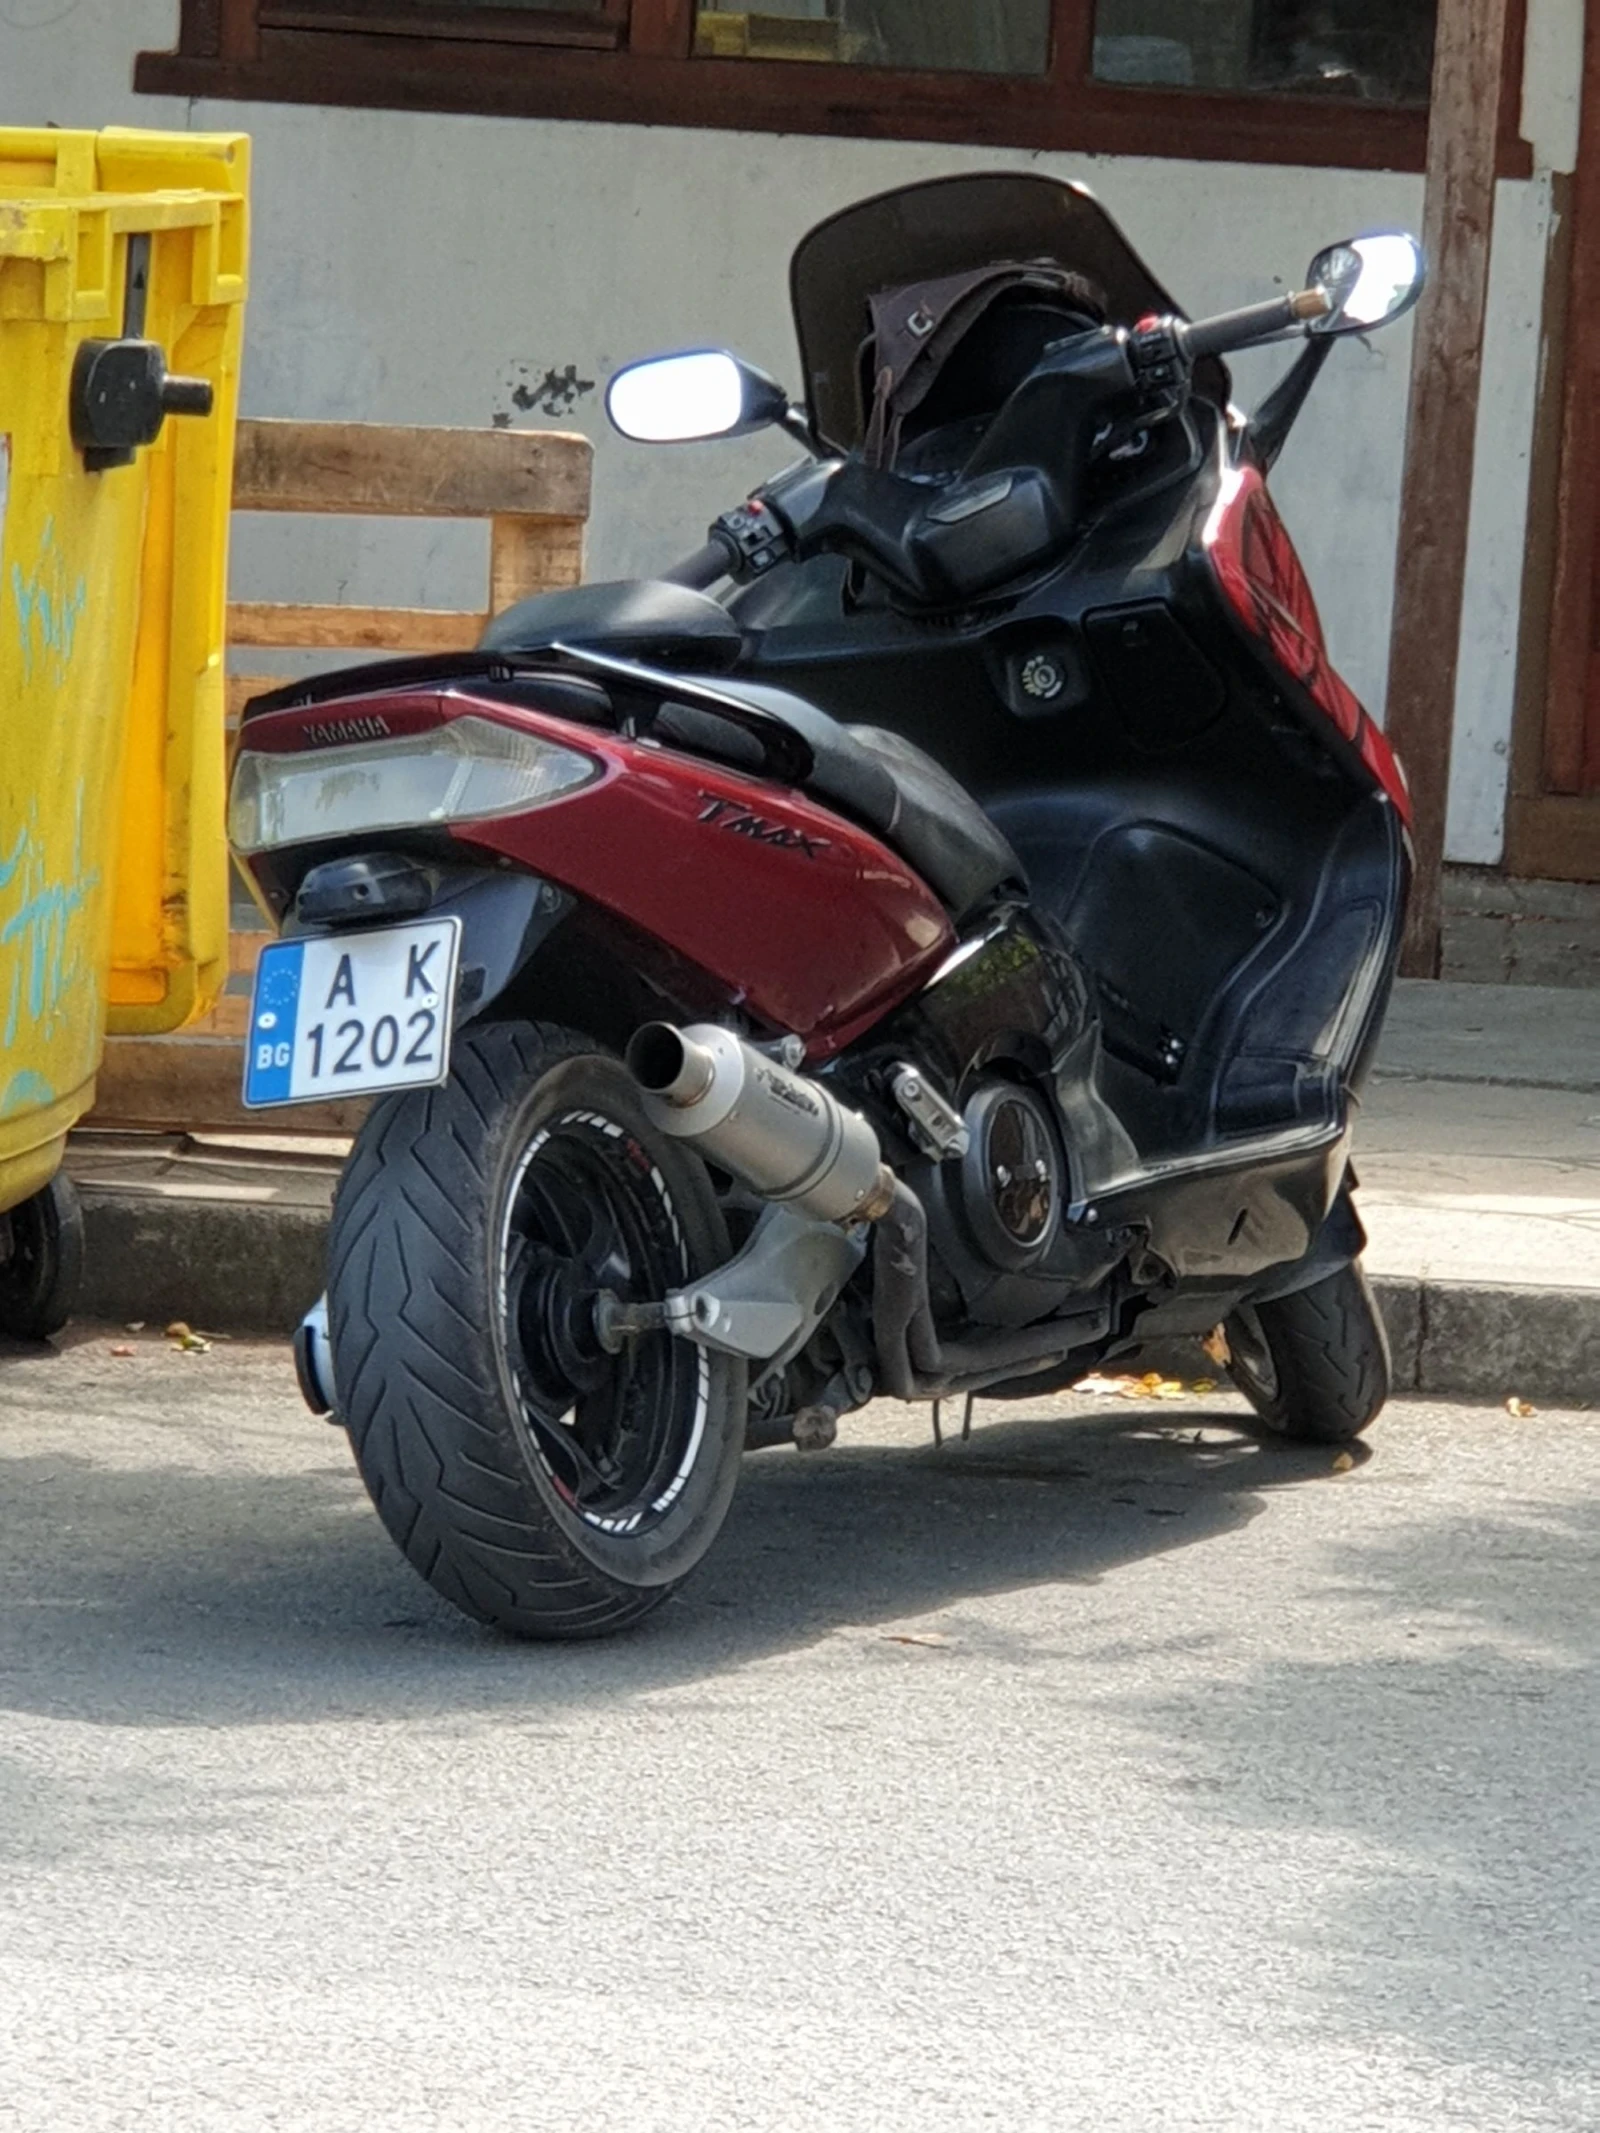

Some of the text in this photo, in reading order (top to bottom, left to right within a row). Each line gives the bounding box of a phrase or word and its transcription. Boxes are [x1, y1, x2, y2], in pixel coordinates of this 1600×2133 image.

[302, 715, 390, 743] YAMAHA
[325, 941, 440, 1009] A K
[256, 1042, 290, 1070] BG
[307, 1010, 437, 1078] 1202
